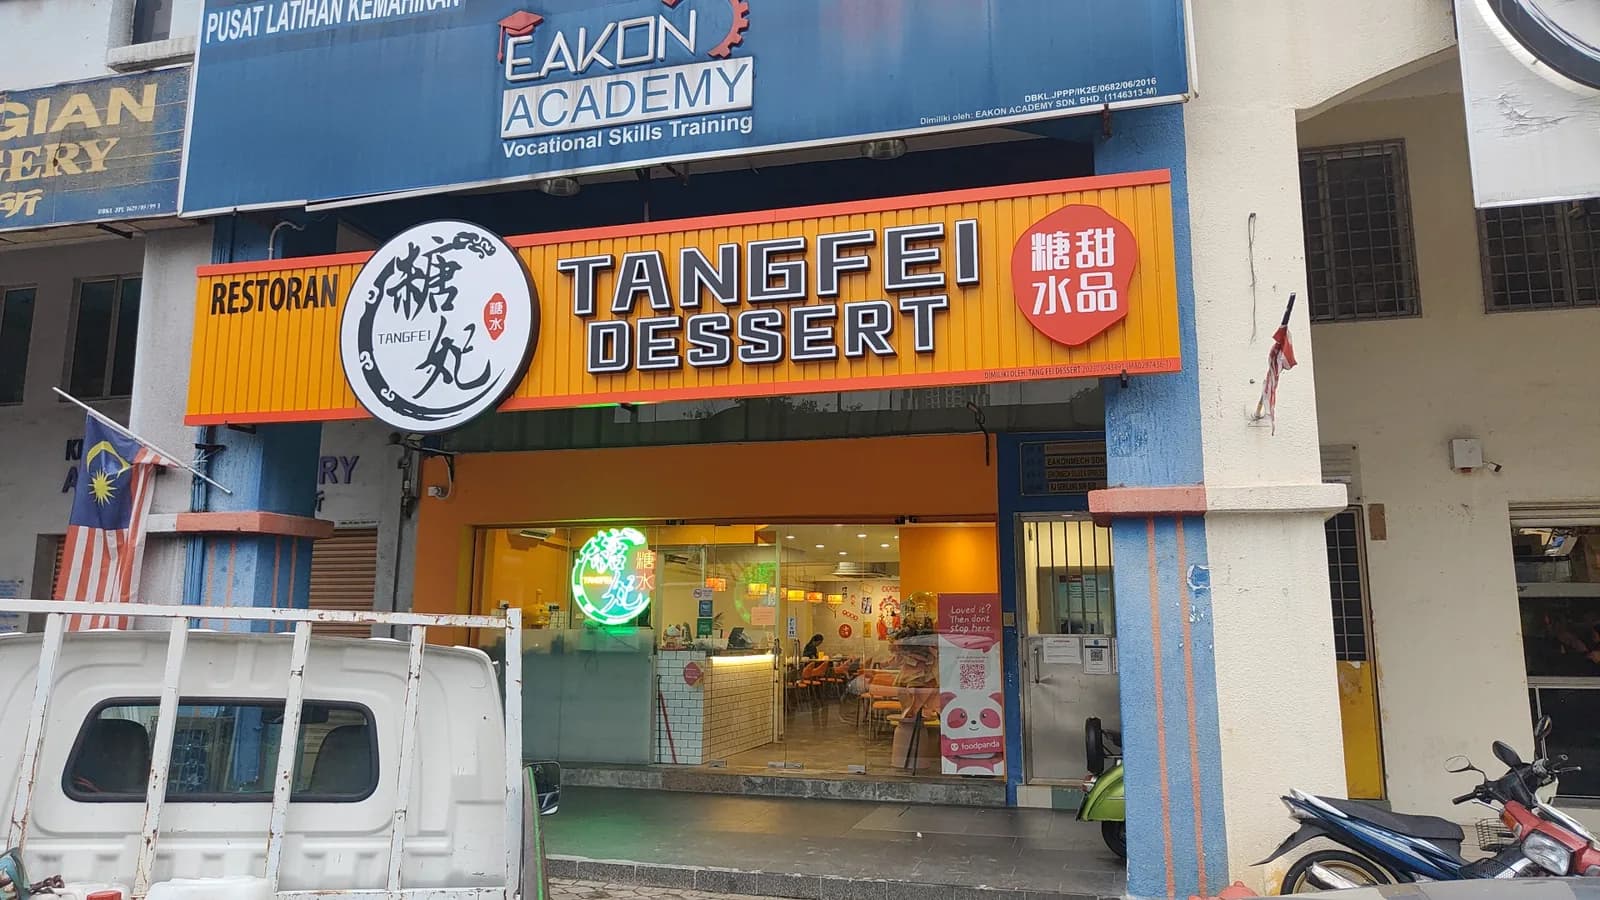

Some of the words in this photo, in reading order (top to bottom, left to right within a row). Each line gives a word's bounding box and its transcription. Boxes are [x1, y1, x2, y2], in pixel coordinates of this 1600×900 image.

[206, 5, 265, 44] PUSAT
[266, 0, 344, 34] LATIHAN
[347, 0, 460, 22] KEMAH
[505, 9, 697, 81] EAKON
[504, 63, 750, 132] ACADEMY
[920, 113, 951, 126] Dimiliki
[952, 111, 973, 122] oleh:
[975, 106, 1007, 119] EAKON
[1009, 100, 1054, 114] ACADEMY
[1056, 98, 1076, 109] SDN.
[1080, 94, 1102, 105] BHD.
[1105, 87, 1158, 103] (1146313-M)
[503, 132, 602, 158] Vocational
[609, 124, 662, 146] Skills
[669, 115, 753, 138] Training
[0, 137, 120, 182] ERY
[557, 218, 980, 317] TANGFEI
[1031, 231, 1072, 315] 糖水
[1075, 227, 1118, 313] 甜品
[211, 273, 338, 315] RESTORAN
[377, 330, 433, 345] TANGFEI
[587, 294, 950, 375] DESSERT
[950, 615, 970, 624] Then
[971, 615, 991, 623] don't
[950, 625, 969, 634] stop
[971, 624, 992, 633] here
[951, 605, 976, 614] Loved
[978, 604, 992, 614] it?
[961, 740, 1000, 751] foodpanda
